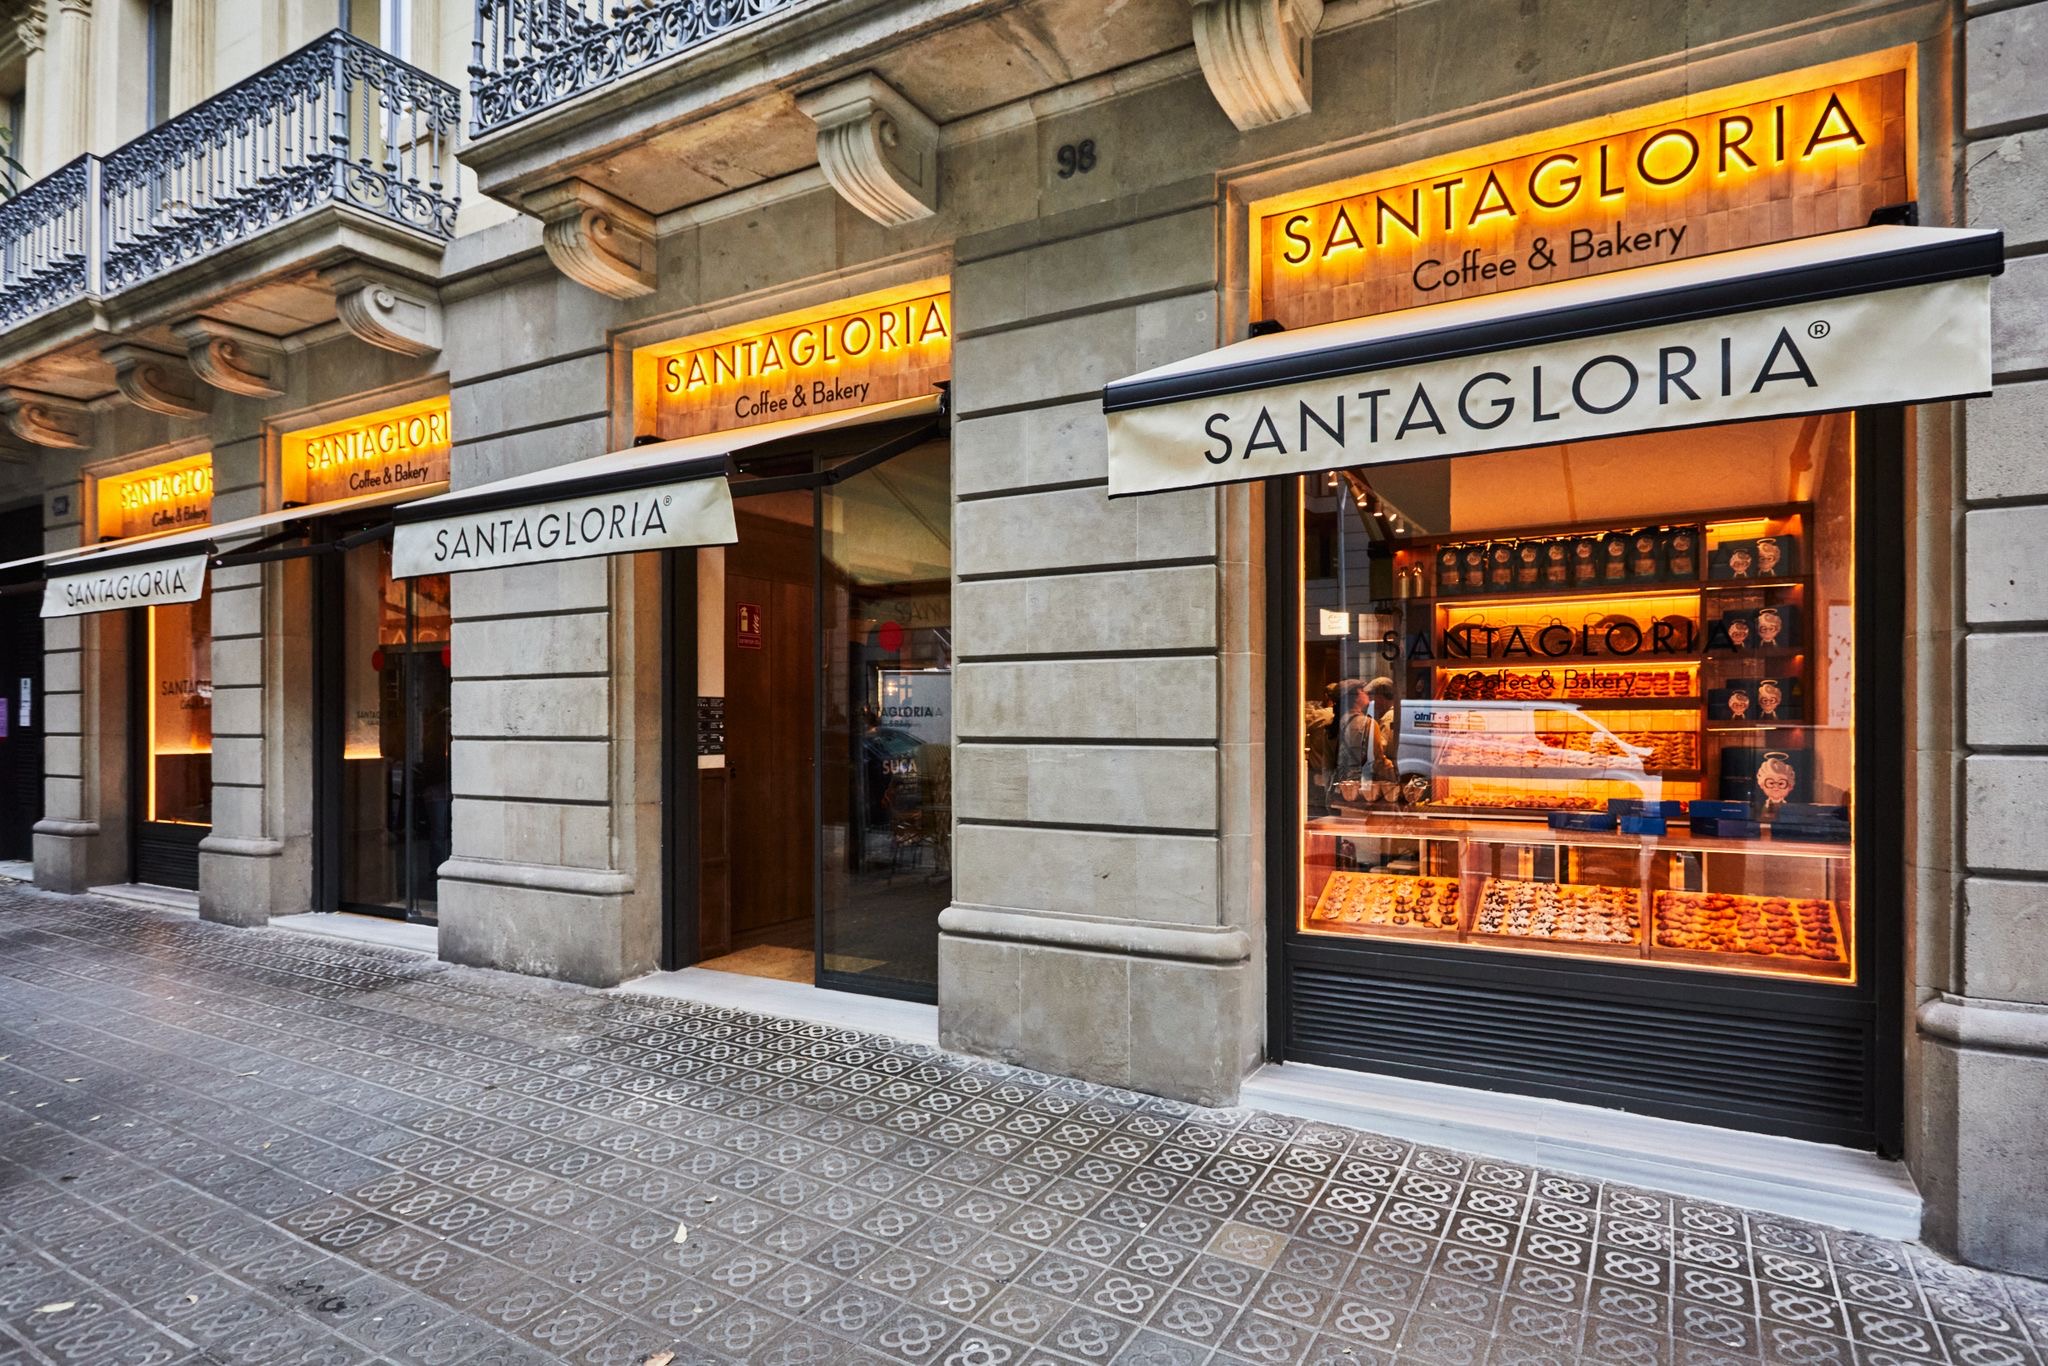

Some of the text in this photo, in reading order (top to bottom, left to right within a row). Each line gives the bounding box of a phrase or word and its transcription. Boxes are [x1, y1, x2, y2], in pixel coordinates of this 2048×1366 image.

[1057, 138, 1097, 179] 98
[1283, 91, 1866, 265] SANTAGLORIA
[1413, 220, 1688, 292] Coffee & Bakery
[665, 300, 948, 393] SANTAGLORIA
[735, 376, 870, 419] Coffee & Bakery
[349, 461, 429, 491] Coffee & Bakery
[1381, 620, 1738, 662] SANTAGLORIA
[1464, 668, 1636, 696] Coffee & Bakery
